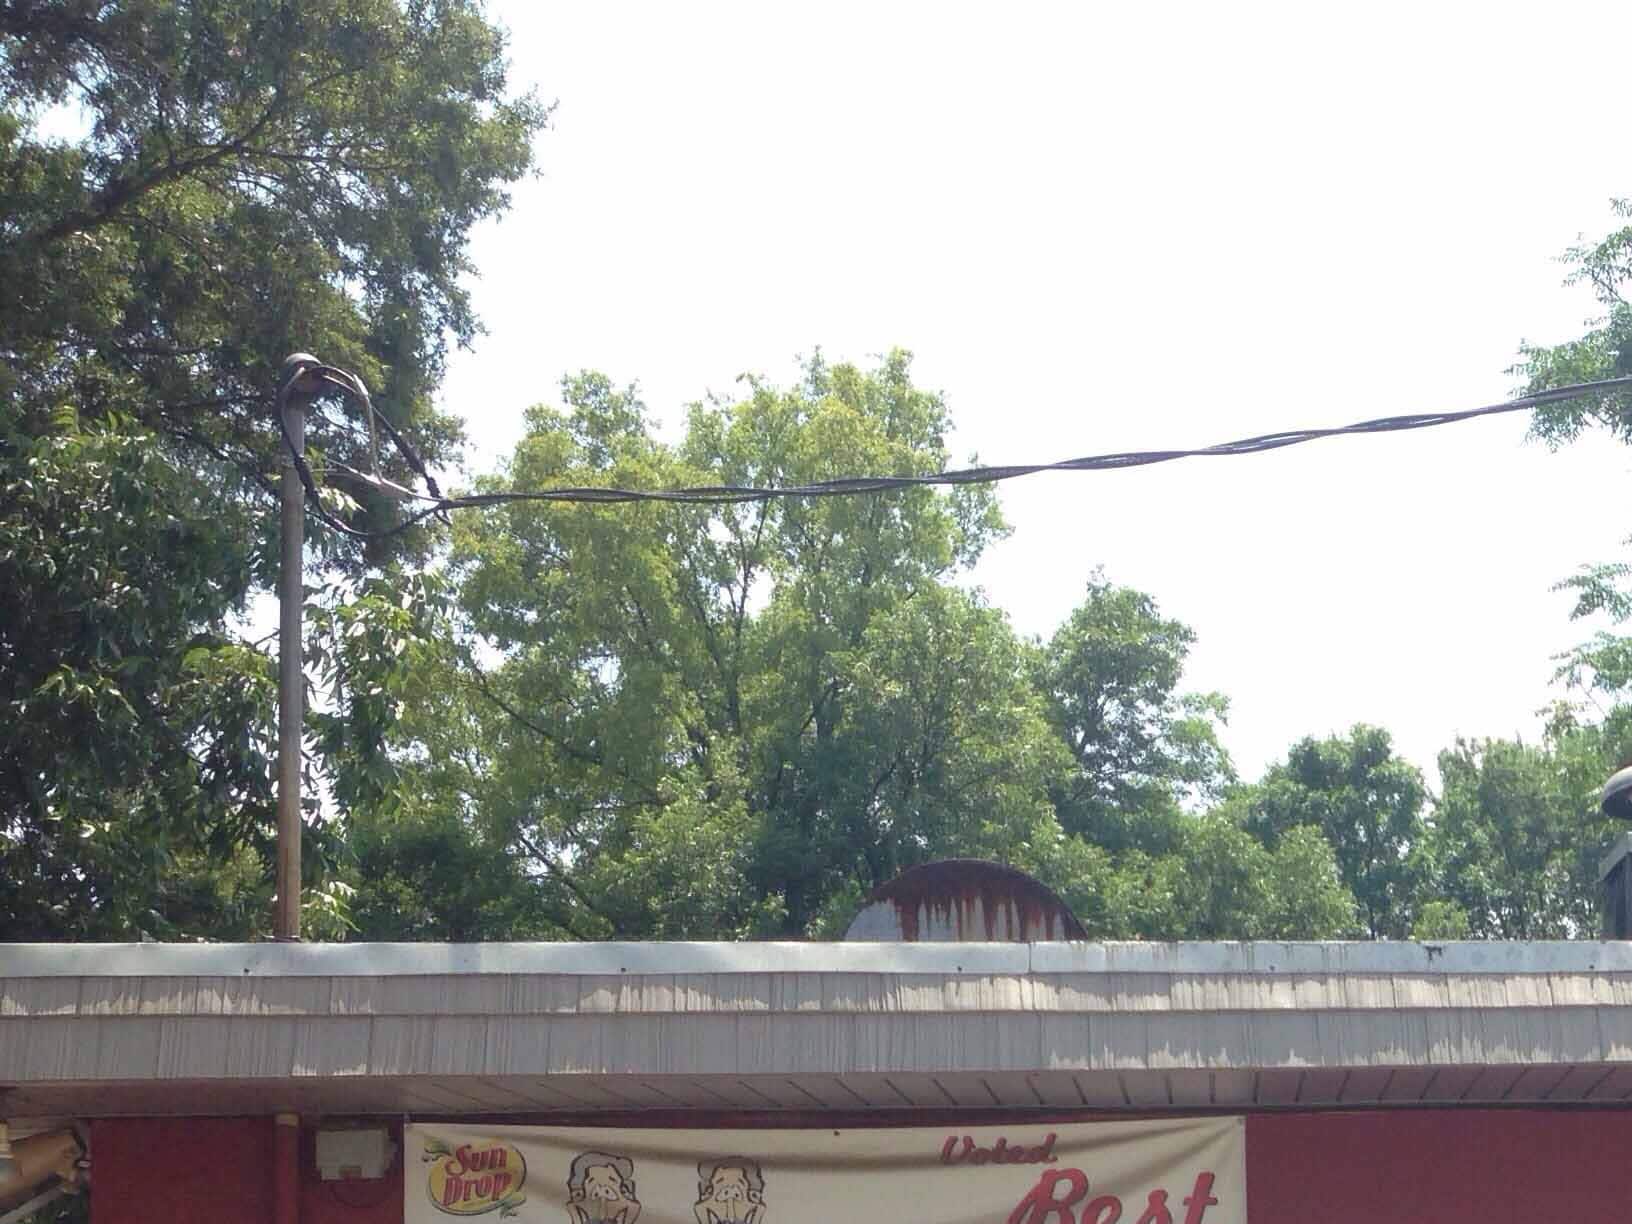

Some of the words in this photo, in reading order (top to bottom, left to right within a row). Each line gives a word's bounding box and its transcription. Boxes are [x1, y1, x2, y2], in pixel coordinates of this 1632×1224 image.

[444, 1143, 508, 1176] Sun
[940, 1132, 1059, 1166] Voted
[442, 1172, 513, 1207] Drop
